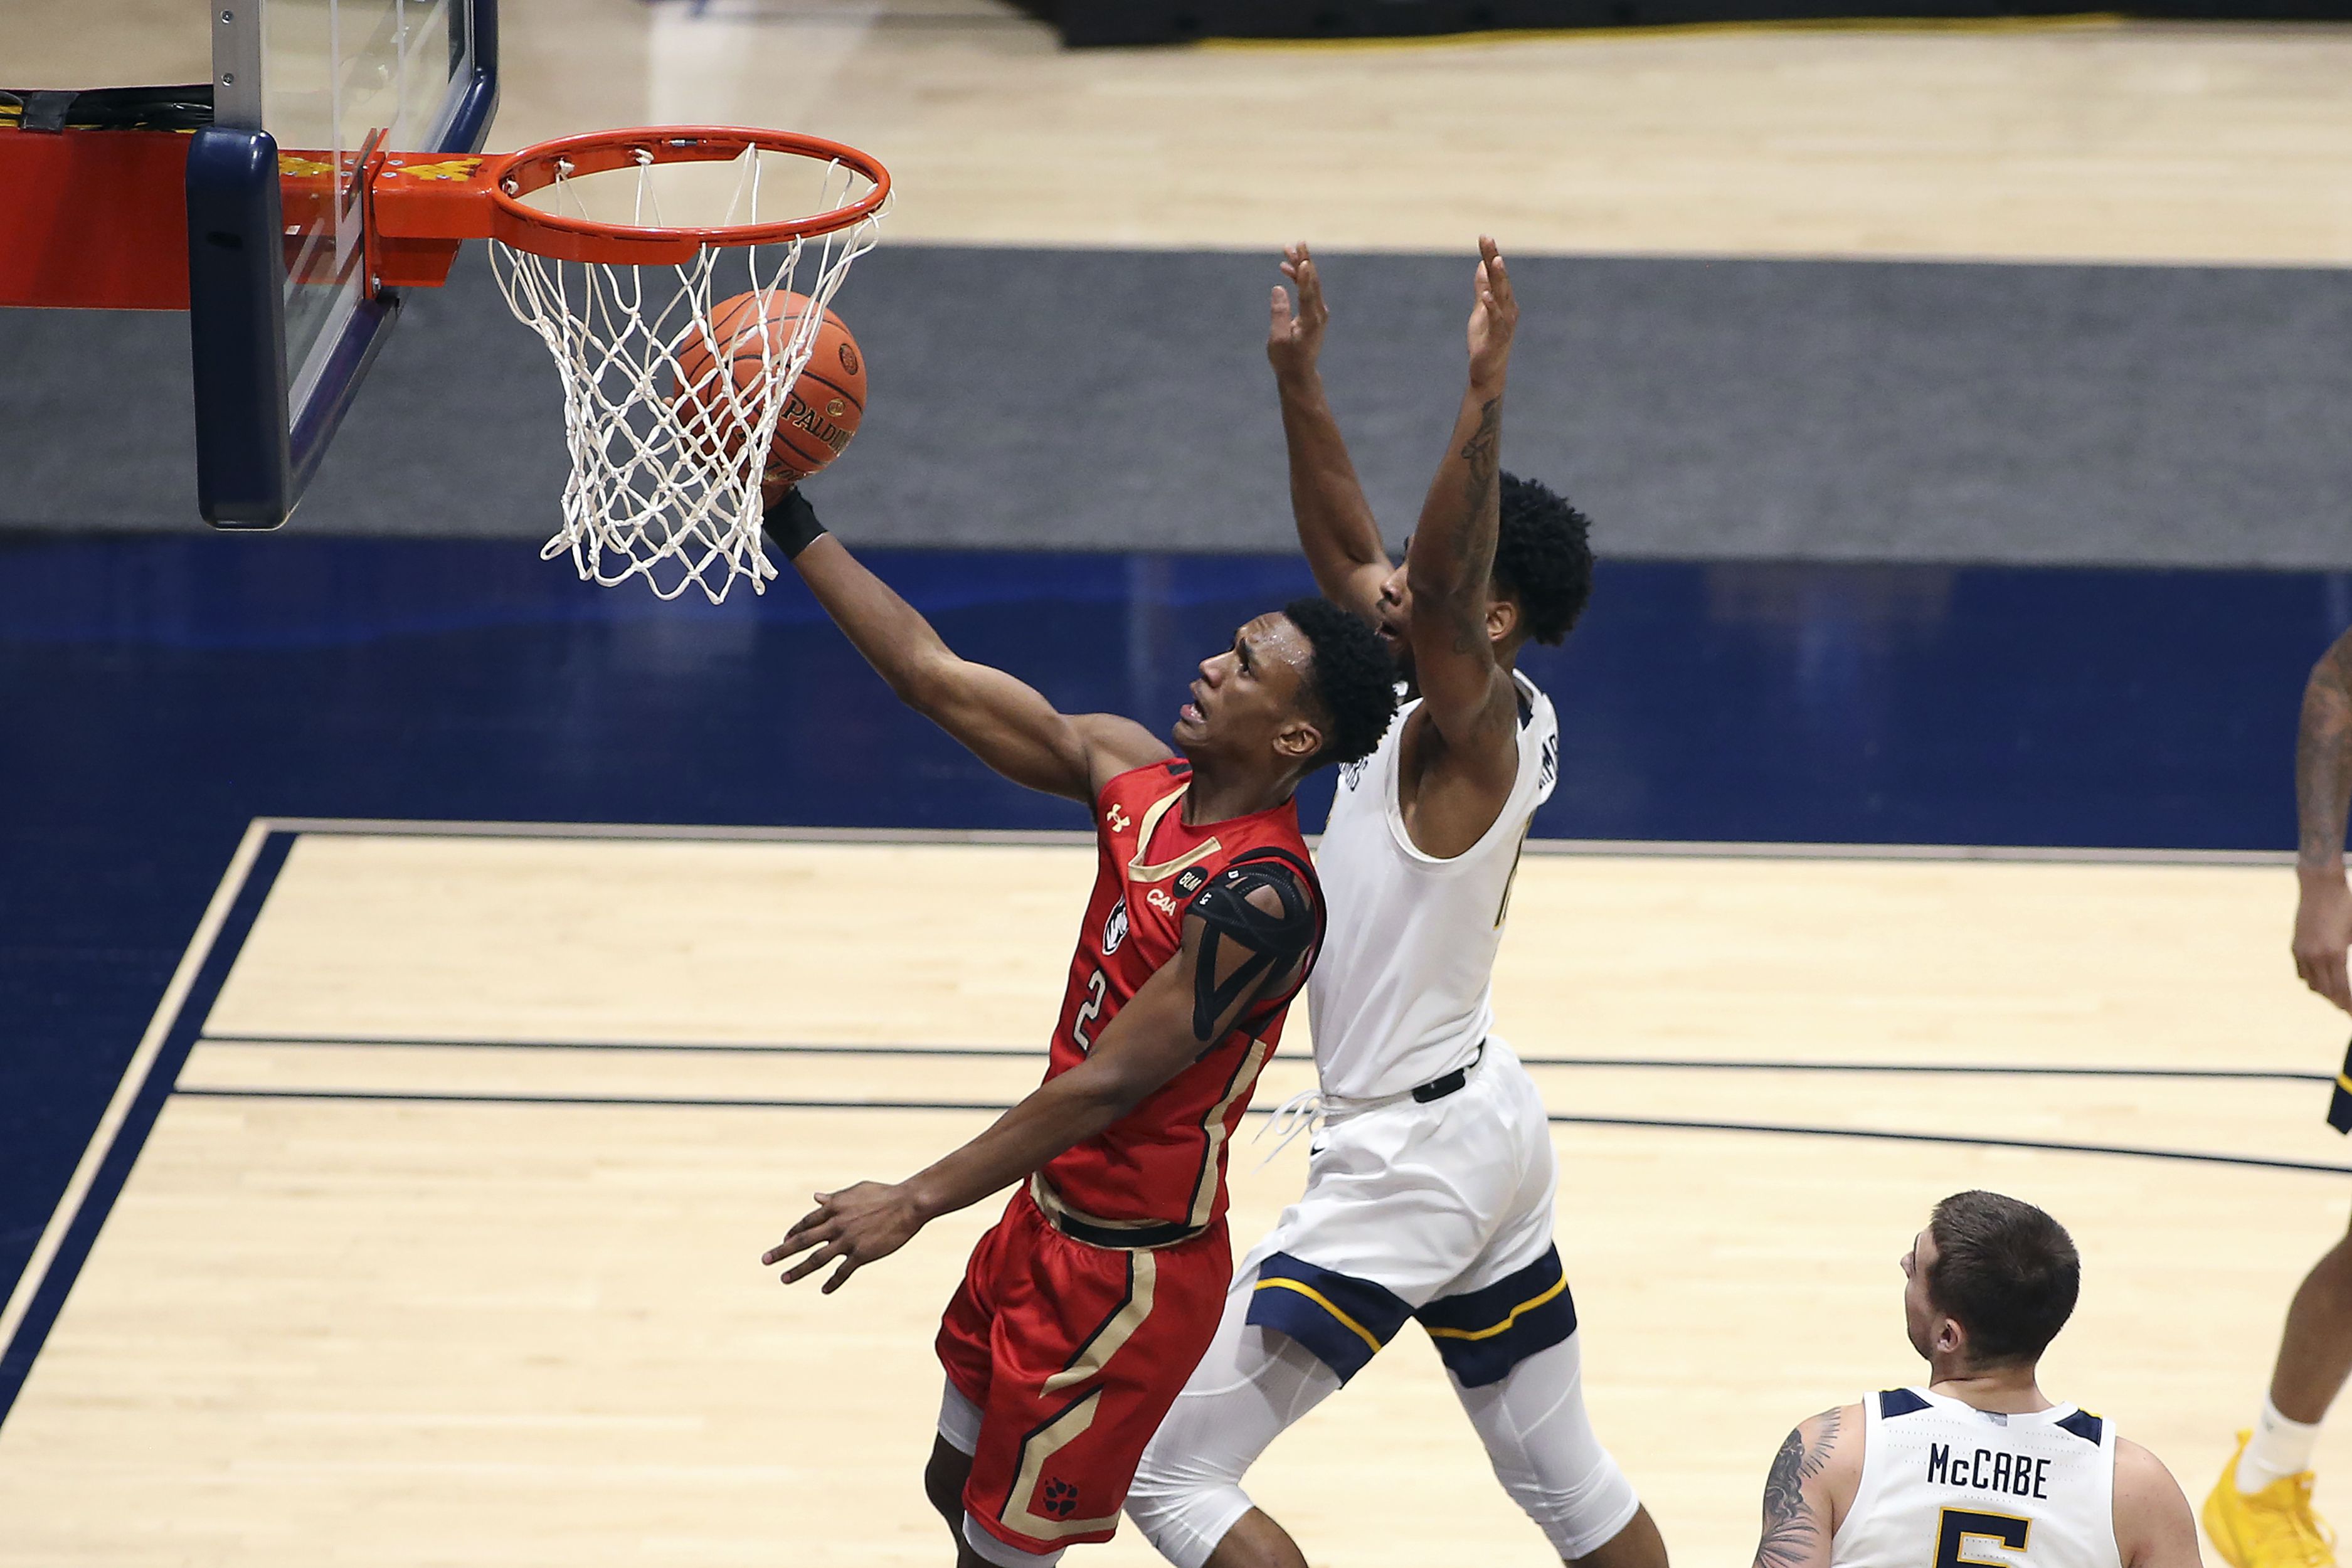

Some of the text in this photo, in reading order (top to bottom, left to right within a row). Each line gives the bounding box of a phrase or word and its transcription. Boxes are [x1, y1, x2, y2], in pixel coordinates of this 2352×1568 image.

[1147, 889, 1177, 916] CAA
[1179, 872, 1202, 891] BLM
[1073, 969, 1106, 1051] 2
[1927, 1443, 2051, 1500] McCABE
